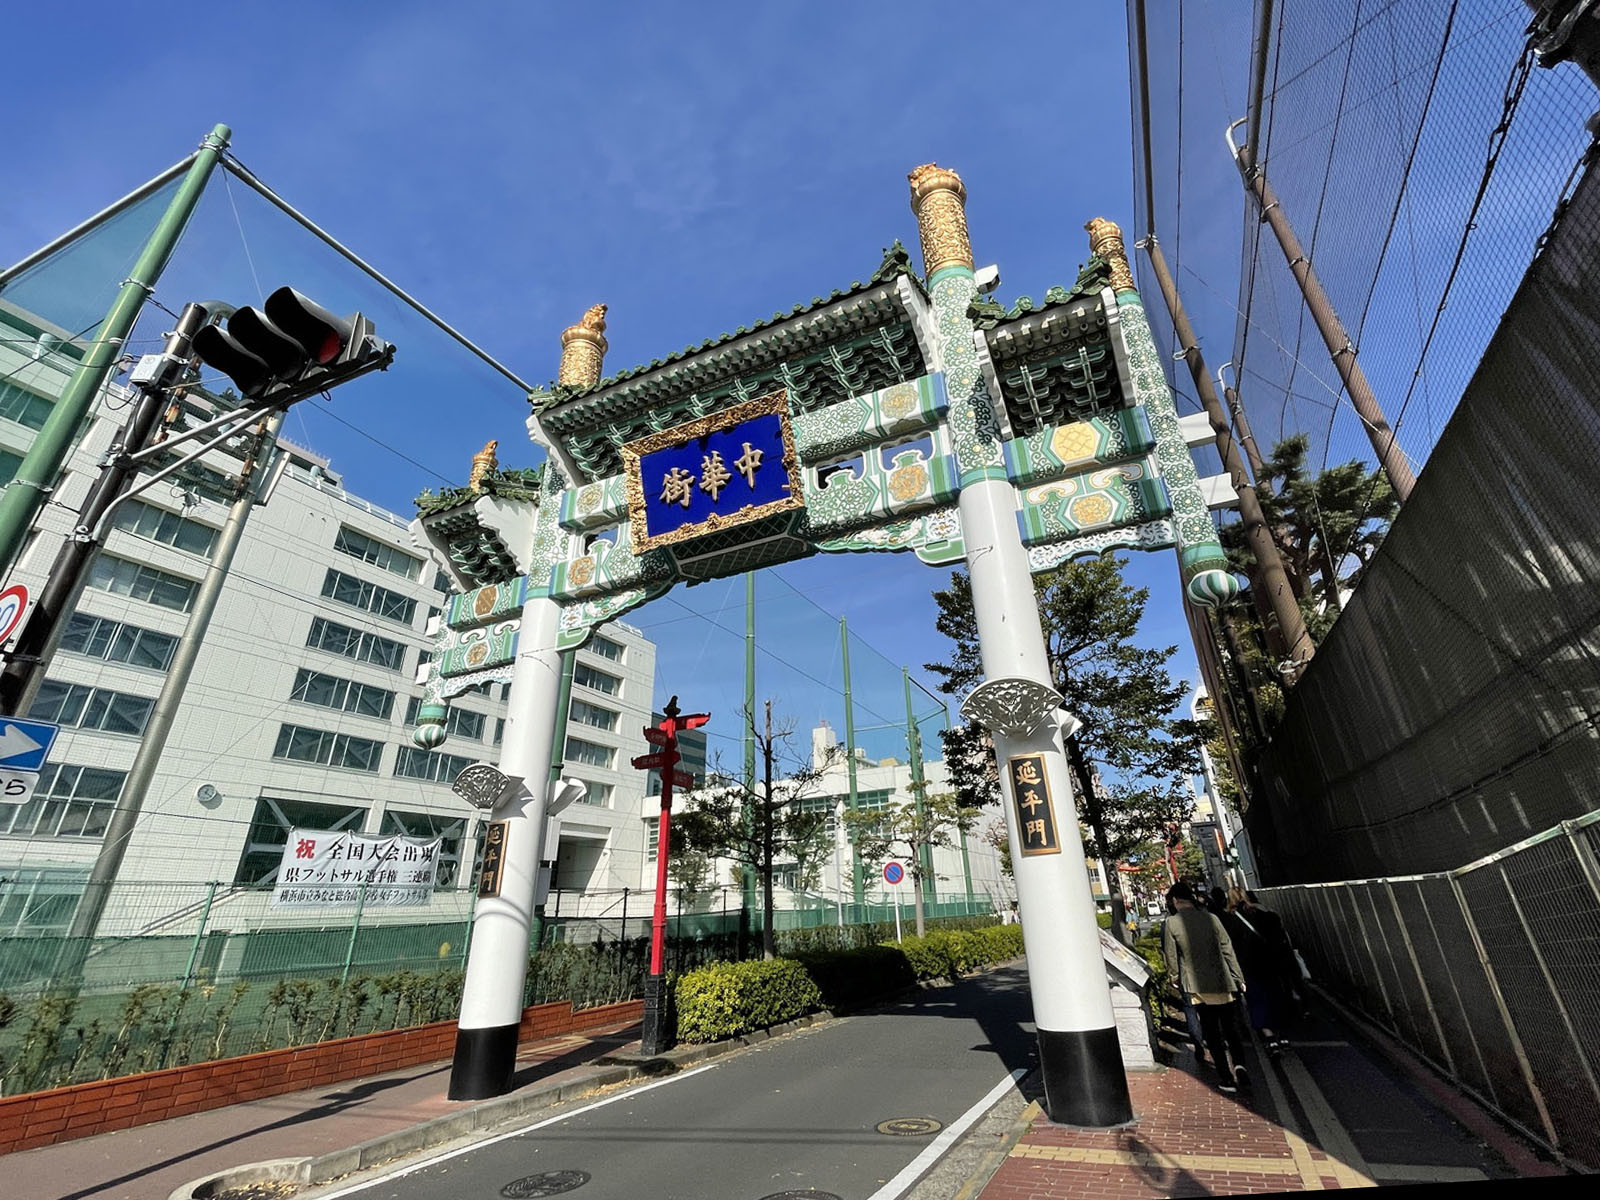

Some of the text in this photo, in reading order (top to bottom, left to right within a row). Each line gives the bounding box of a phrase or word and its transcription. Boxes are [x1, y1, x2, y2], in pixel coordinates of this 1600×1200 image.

[659, 443, 764, 507] 中華街
[0, 604, 15, 632] 0
[0, 778, 26, 796] ら
[1016, 761, 1047, 846] 延平門
[296, 838, 433, 864] 祝 全国大会出場
[482, 826, 501, 891] 延平門
[285, 867, 398, 883] 県フットサル選手権
